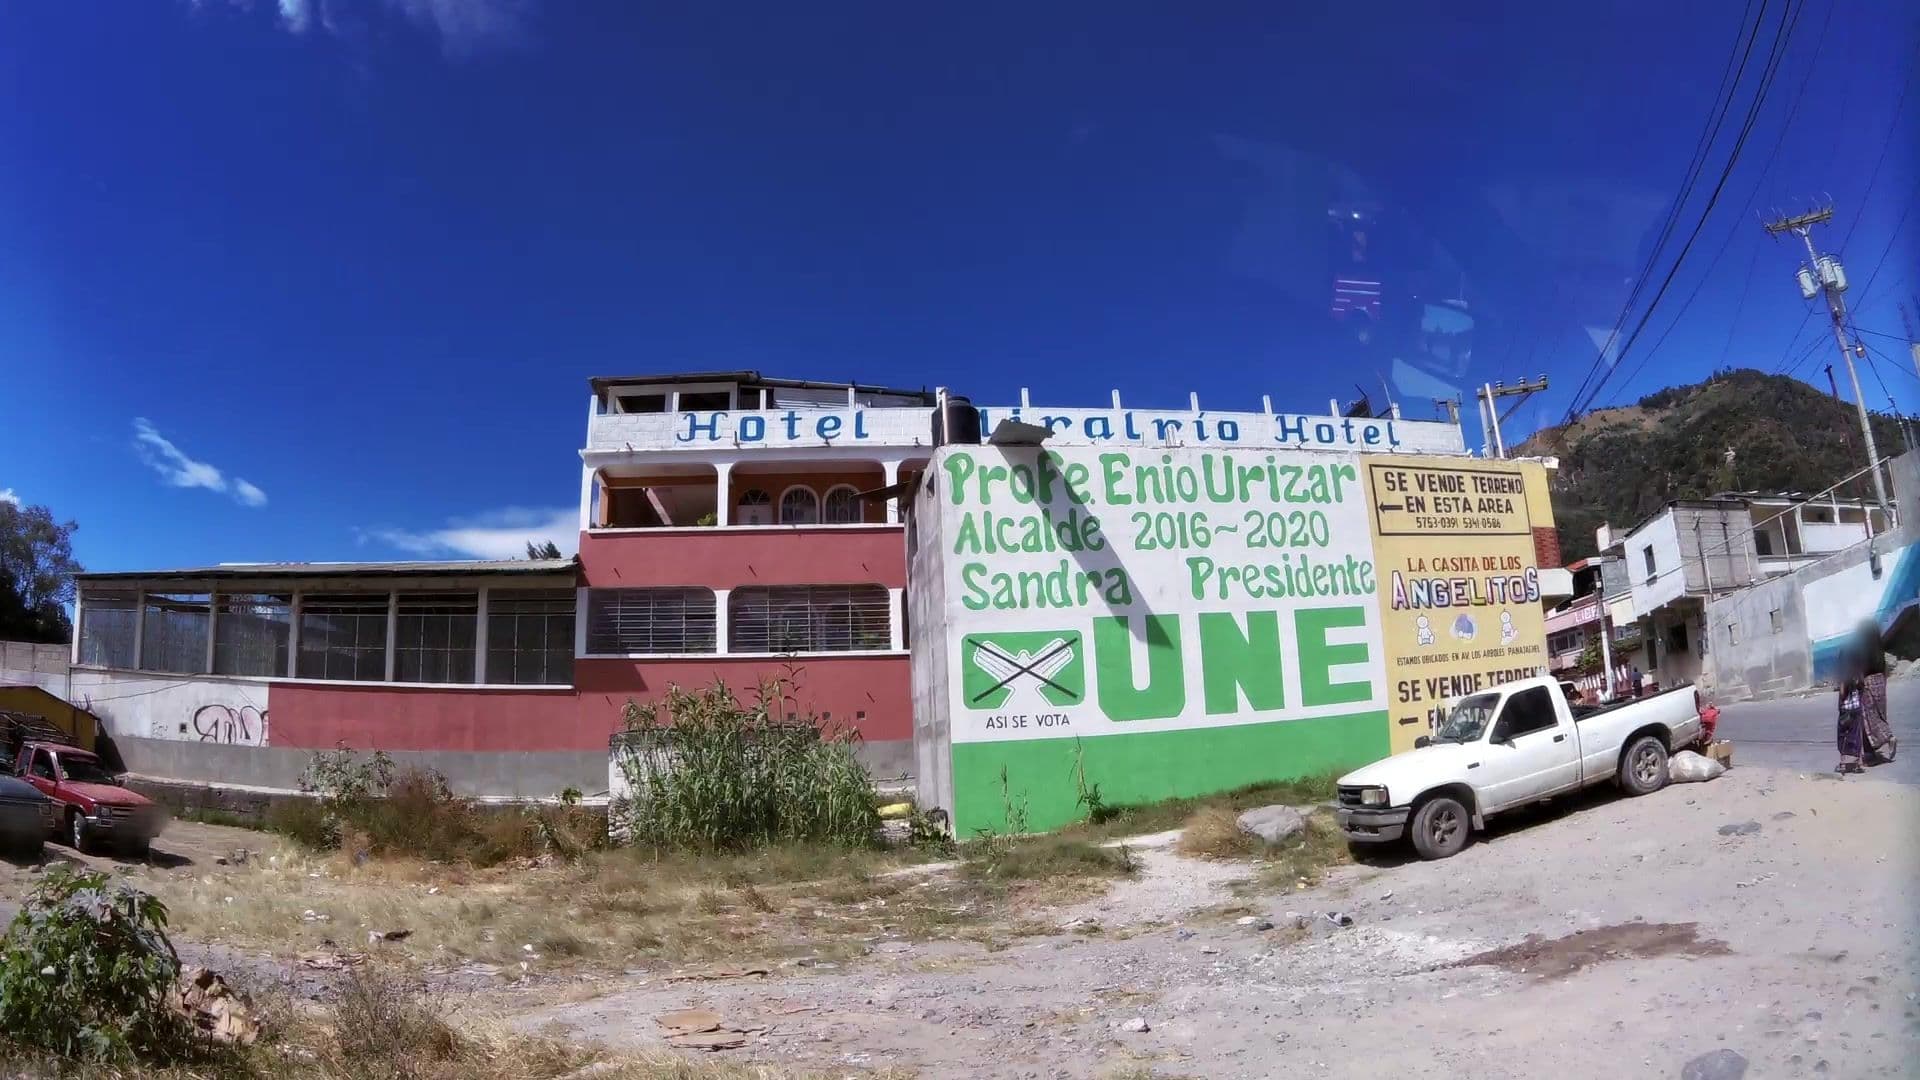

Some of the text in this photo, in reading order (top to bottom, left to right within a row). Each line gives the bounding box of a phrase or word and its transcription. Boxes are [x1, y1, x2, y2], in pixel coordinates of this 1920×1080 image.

[676, 410, 869, 442] Hotel
[1274, 414, 1401, 446] Hotel
[1099, 452, 1198, 505] Enio
[1202, 453, 1357, 504] Urizar
[1384, 471, 1523, 495] SE VENDE TERRENO
[1405, 495, 1514, 514] EN ESTA AREA
[953, 507, 1105, 554] Alcalde
[961, 552, 1377, 611] Sandra Presidente
[1407, 556, 1522, 573] LA CASITA DE LOS
[1391, 565, 1541, 611] ANGELITOS
[1093, 605, 1374, 722] UNE
[1398, 679, 1422, 703] SE
[1425, 673, 1482, 700] VENDE
[986, 713, 1070, 729] ASI SE VOTA
